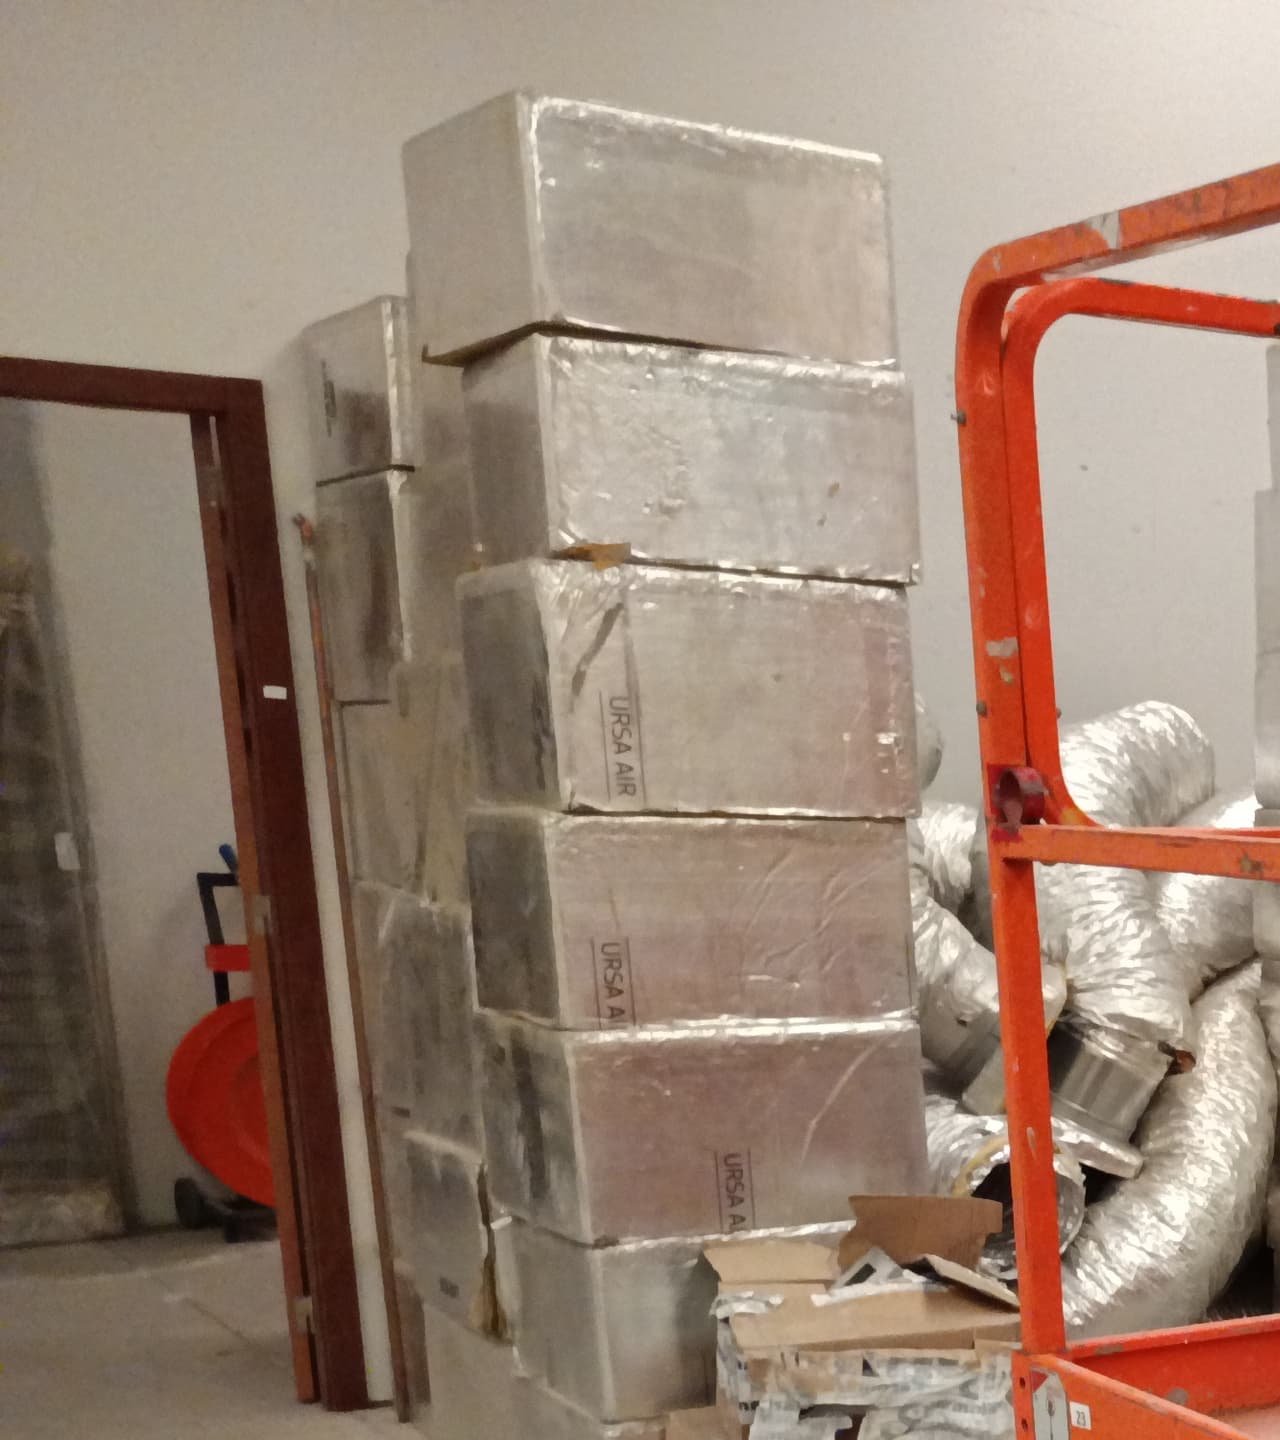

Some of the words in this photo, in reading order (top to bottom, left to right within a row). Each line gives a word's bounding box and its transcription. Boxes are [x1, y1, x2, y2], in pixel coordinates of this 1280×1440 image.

[609, 696, 633, 755] URSA
[615, 761, 637, 797] AIR
[601, 942, 624, 999] URSA
[723, 1153, 745, 1208] URSA
[1076, 1410, 1087, 1427] 23
